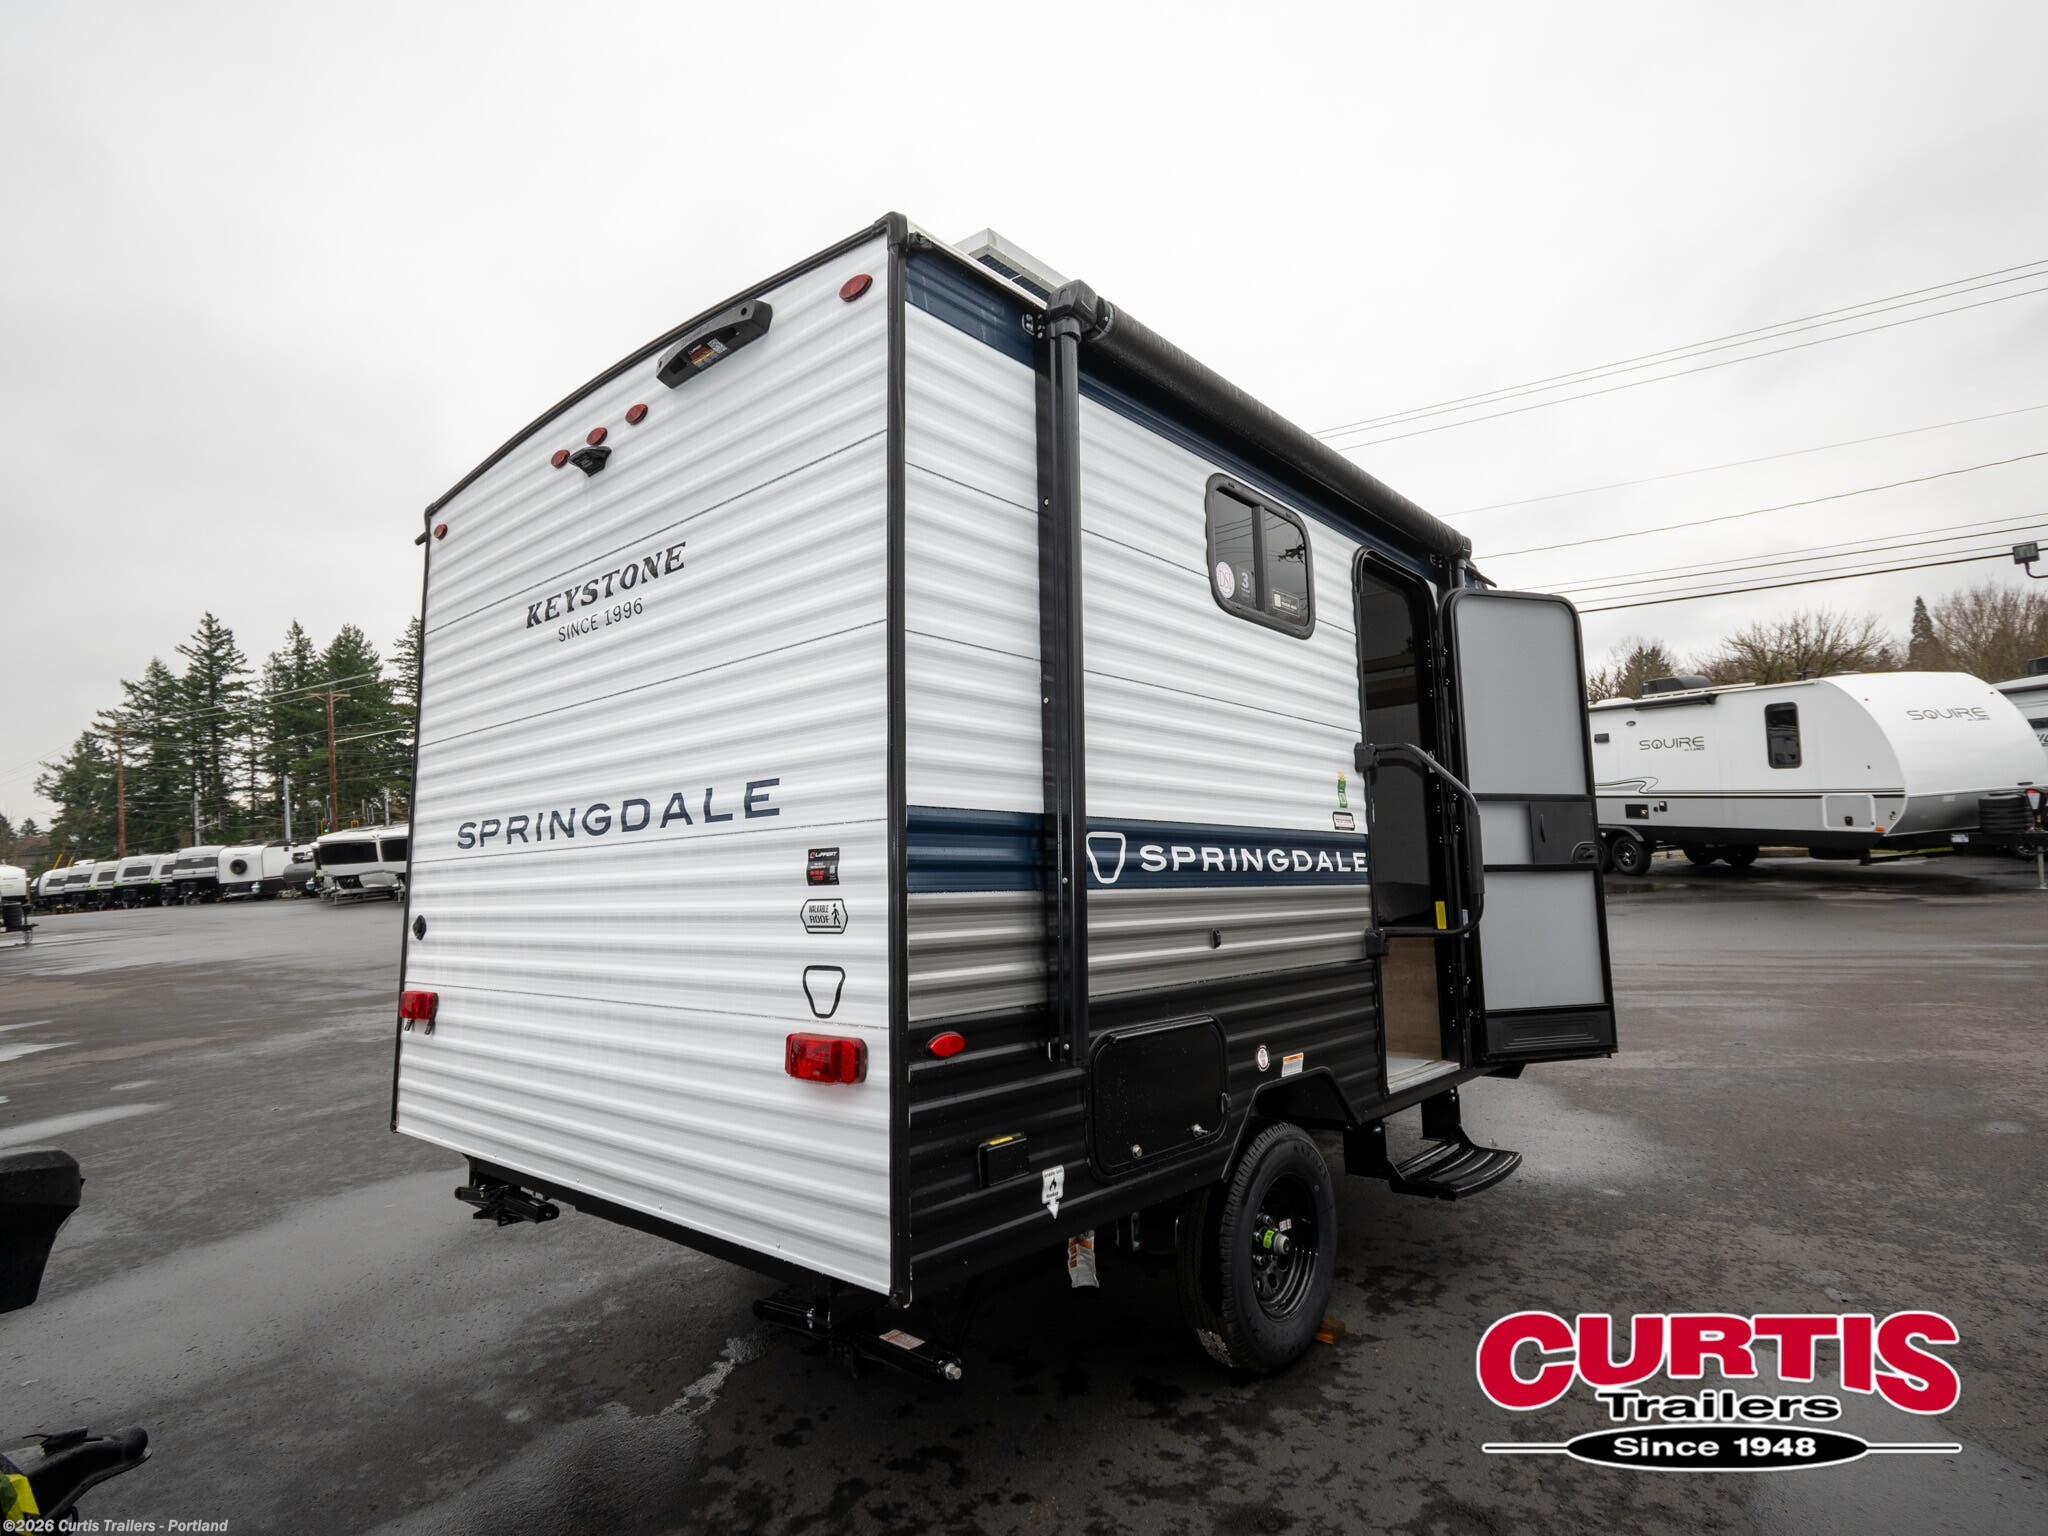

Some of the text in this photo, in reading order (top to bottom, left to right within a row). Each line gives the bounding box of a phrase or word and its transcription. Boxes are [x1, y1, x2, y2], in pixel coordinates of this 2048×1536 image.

[526, 541, 686, 629] KEYSTONE
[558, 597, 643, 642] SINCE 1996
[1906, 707, 1989, 720] SQUIRE
[1639, 736, 1704, 751] SQUIRE
[457, 778, 781, 850] SPRINGDALE
[1139, 844, 1368, 872] SPRINGDALE
[808, 904, 829, 914] WALKABLE
[809, 915, 829, 924] ROOF
